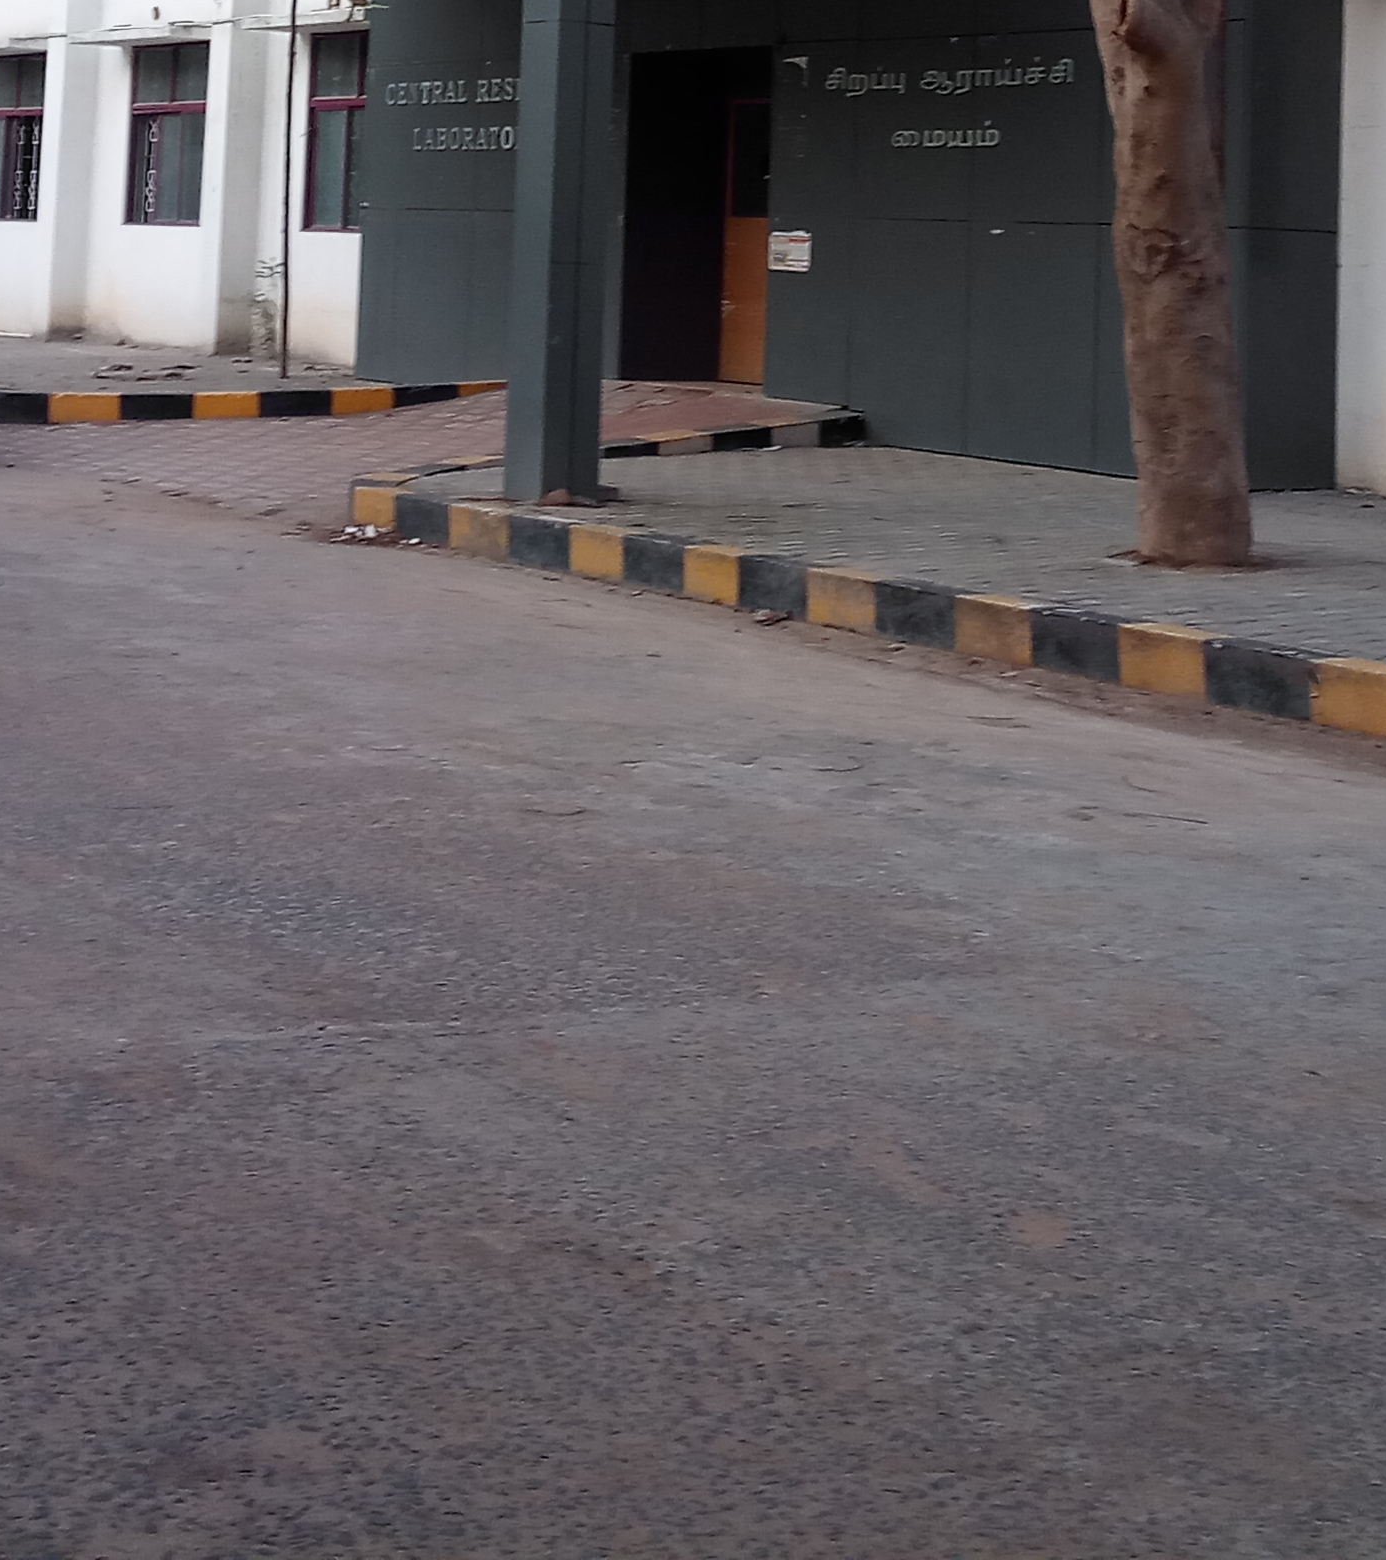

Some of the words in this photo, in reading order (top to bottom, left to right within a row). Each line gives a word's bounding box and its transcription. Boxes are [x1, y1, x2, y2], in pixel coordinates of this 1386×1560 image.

[824, 66, 907, 97] சிறப்பு
[919, 56, 1075, 95] ஆராய்ச்சி
[385, 80, 468, 106] CENTRAL
[412, 125, 518, 151] LABORATO
[891, 119, 1002, 148] மையம்
